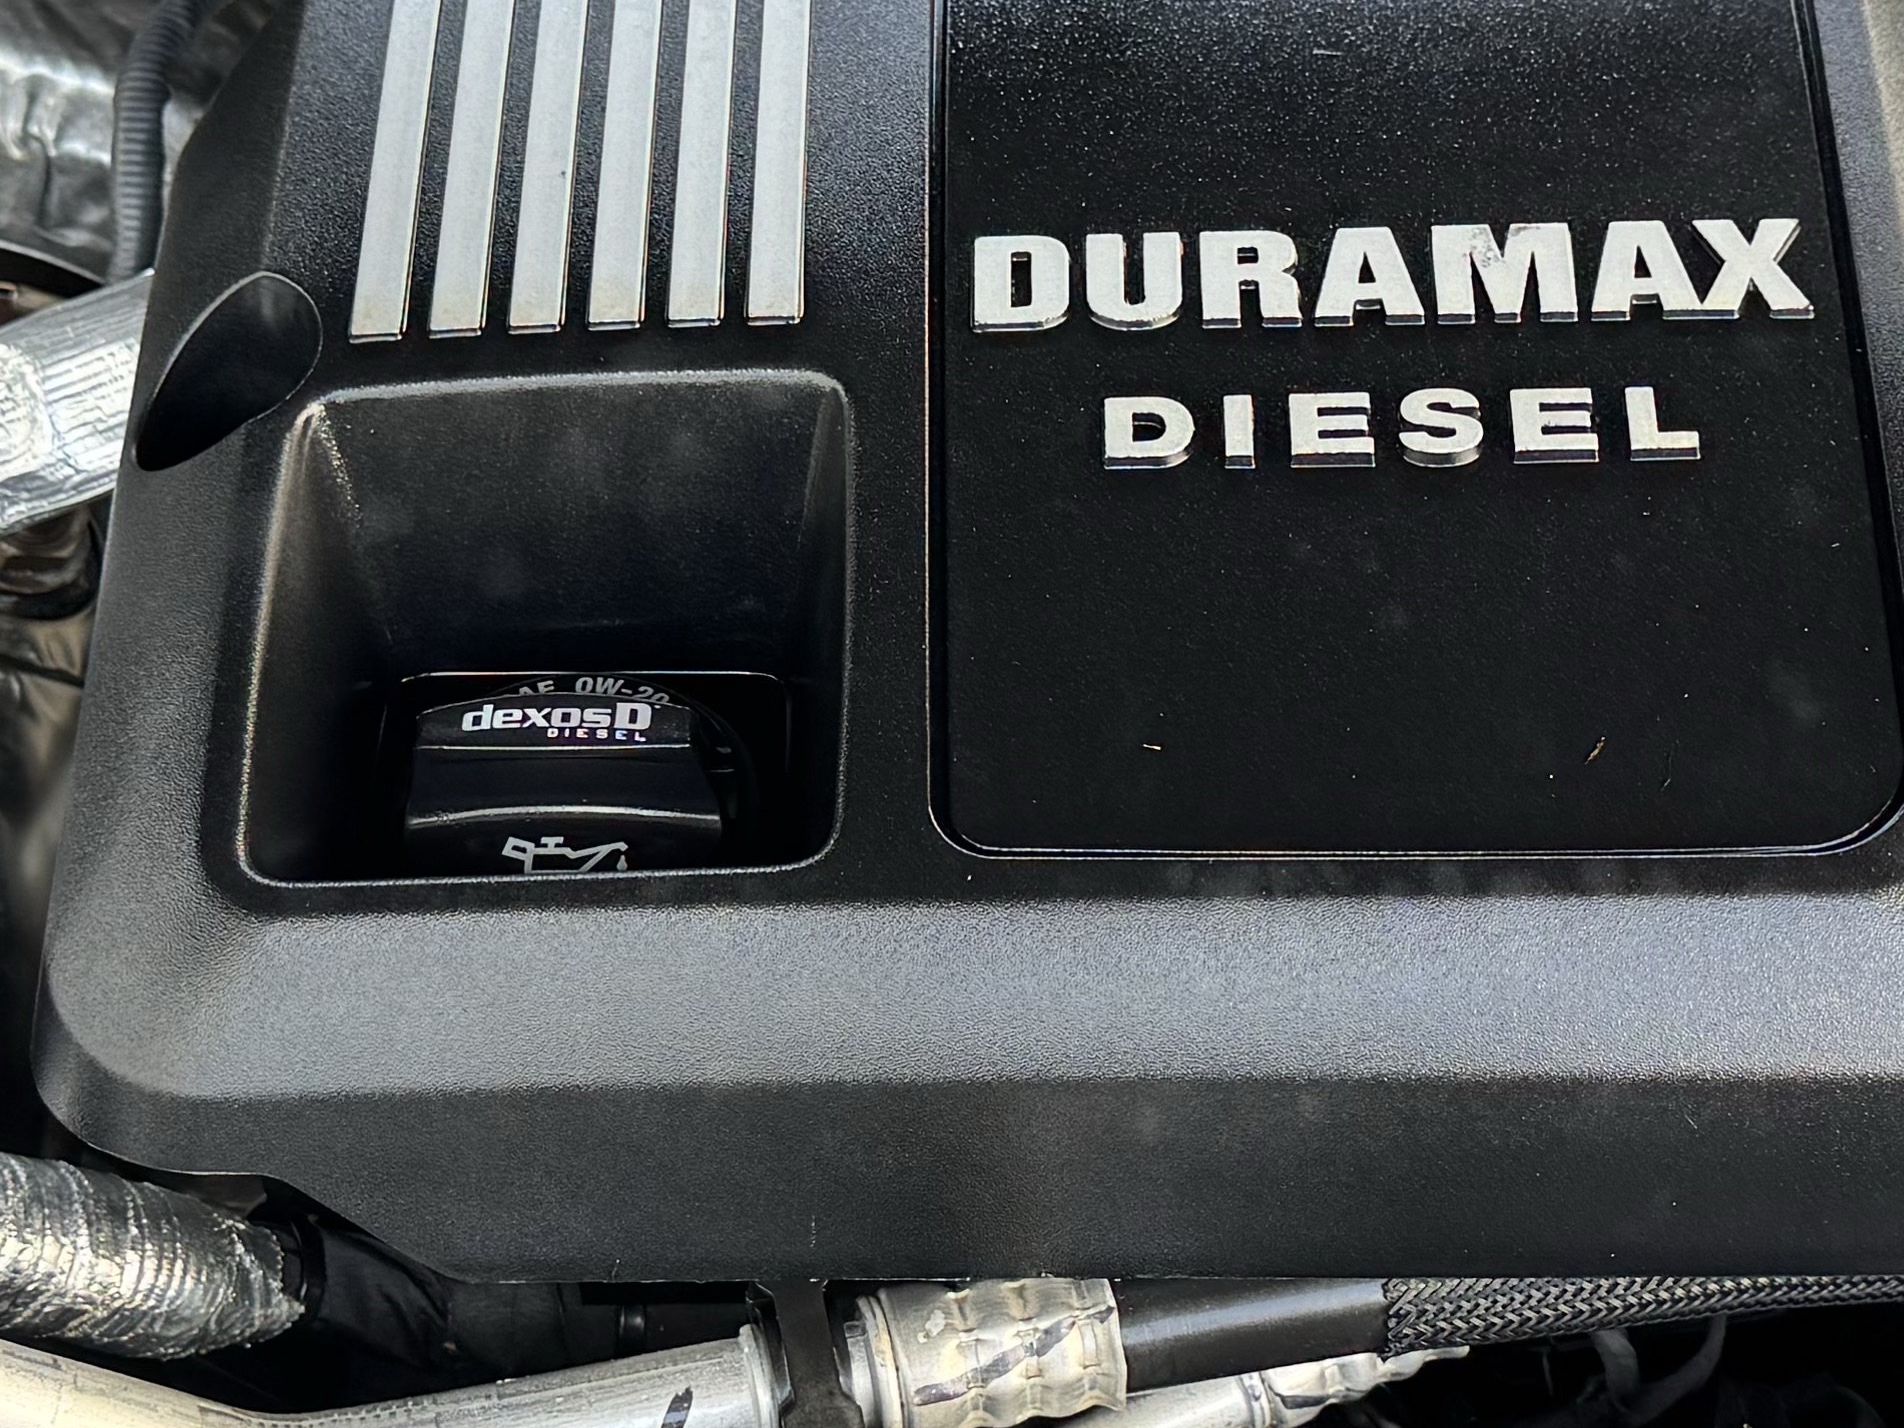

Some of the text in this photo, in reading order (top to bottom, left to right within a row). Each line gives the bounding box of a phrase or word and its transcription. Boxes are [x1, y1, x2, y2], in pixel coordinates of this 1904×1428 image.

[970, 217, 1814, 333] DURAMAX
[1102, 385, 1702, 469] DIESEL
[546, 727, 647, 742] DIESEL
